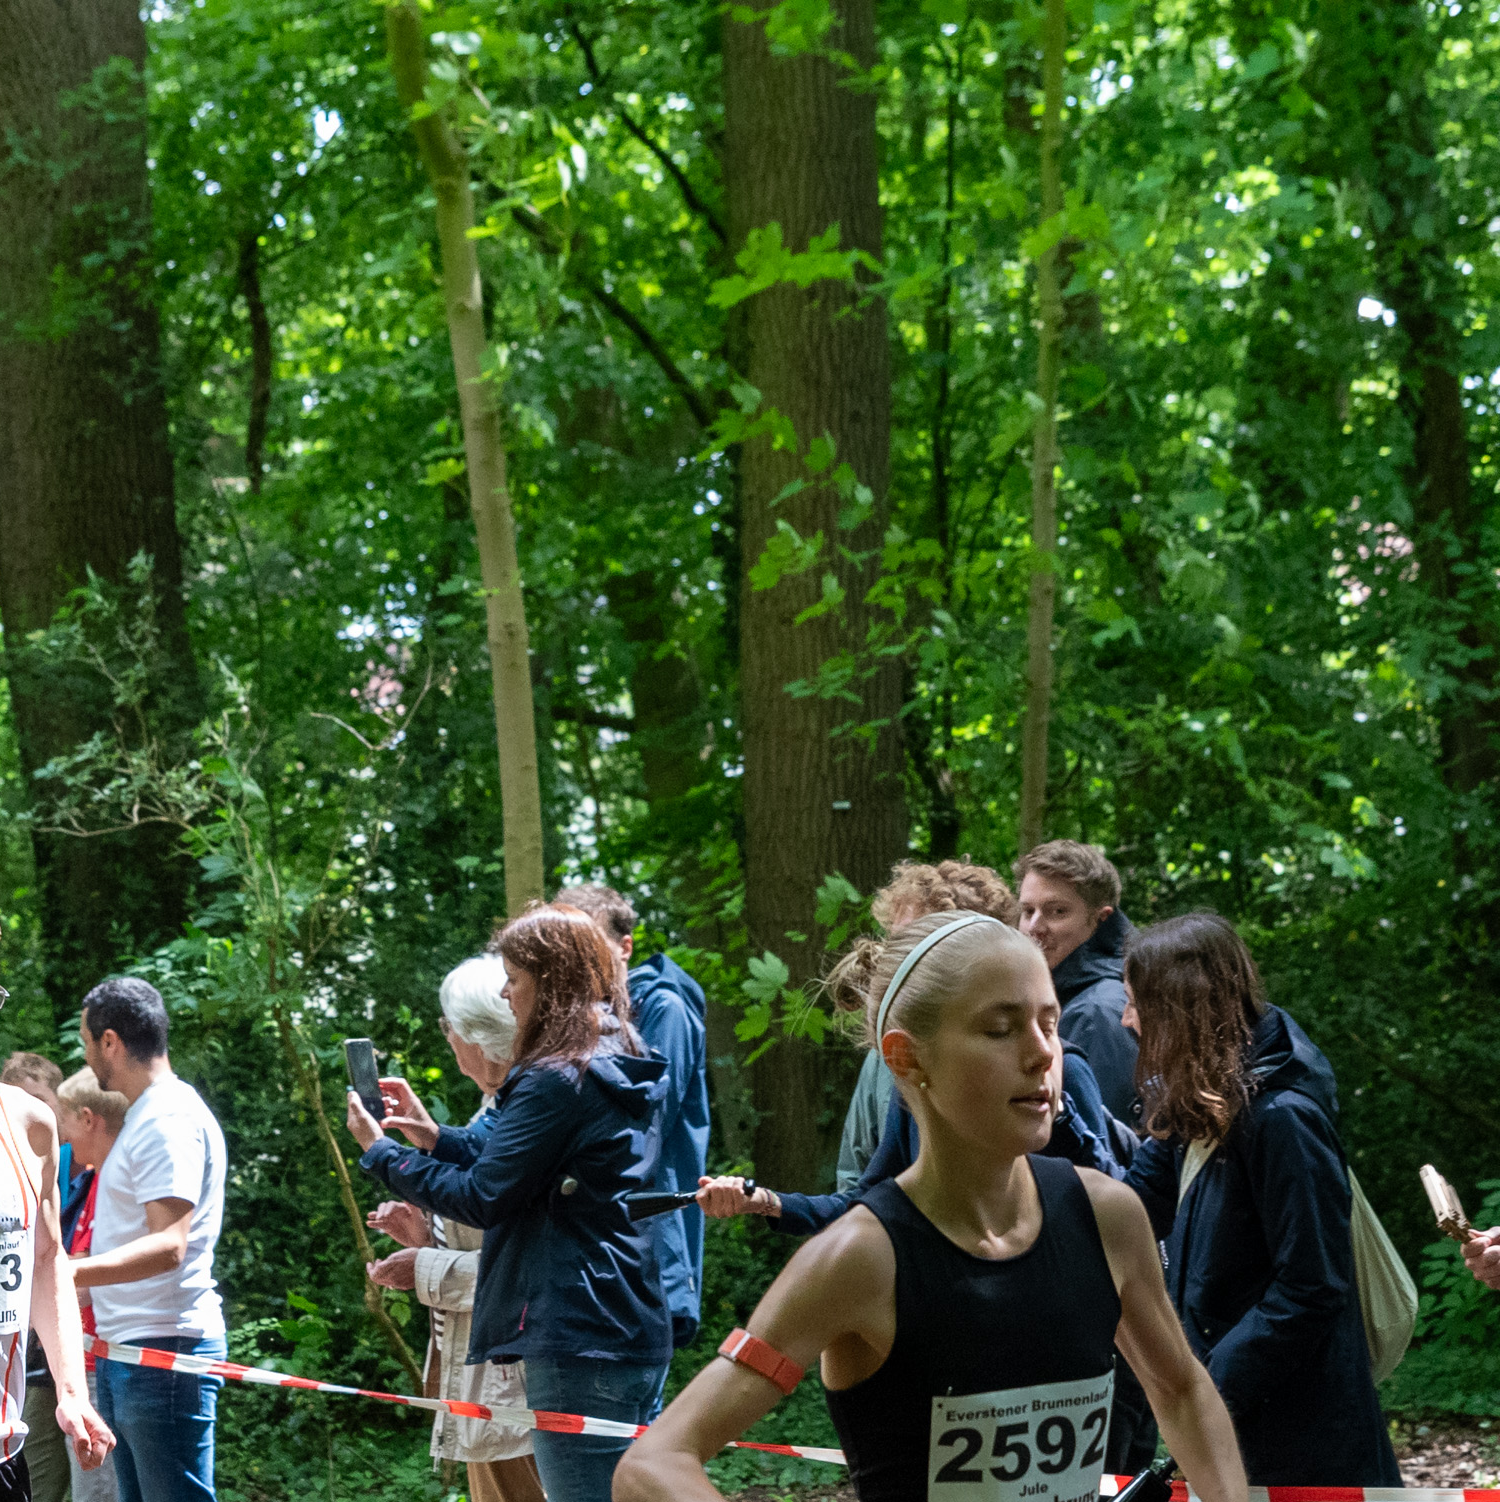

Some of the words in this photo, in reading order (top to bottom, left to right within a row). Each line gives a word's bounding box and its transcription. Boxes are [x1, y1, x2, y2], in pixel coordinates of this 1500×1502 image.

[946, 1404, 1028, 1422] Everstener
[1031, 1387, 1109, 1412] Brunnenlauf
[934, 1406, 1108, 1483] 2592
[1019, 1482, 1049, 1497] Jule
